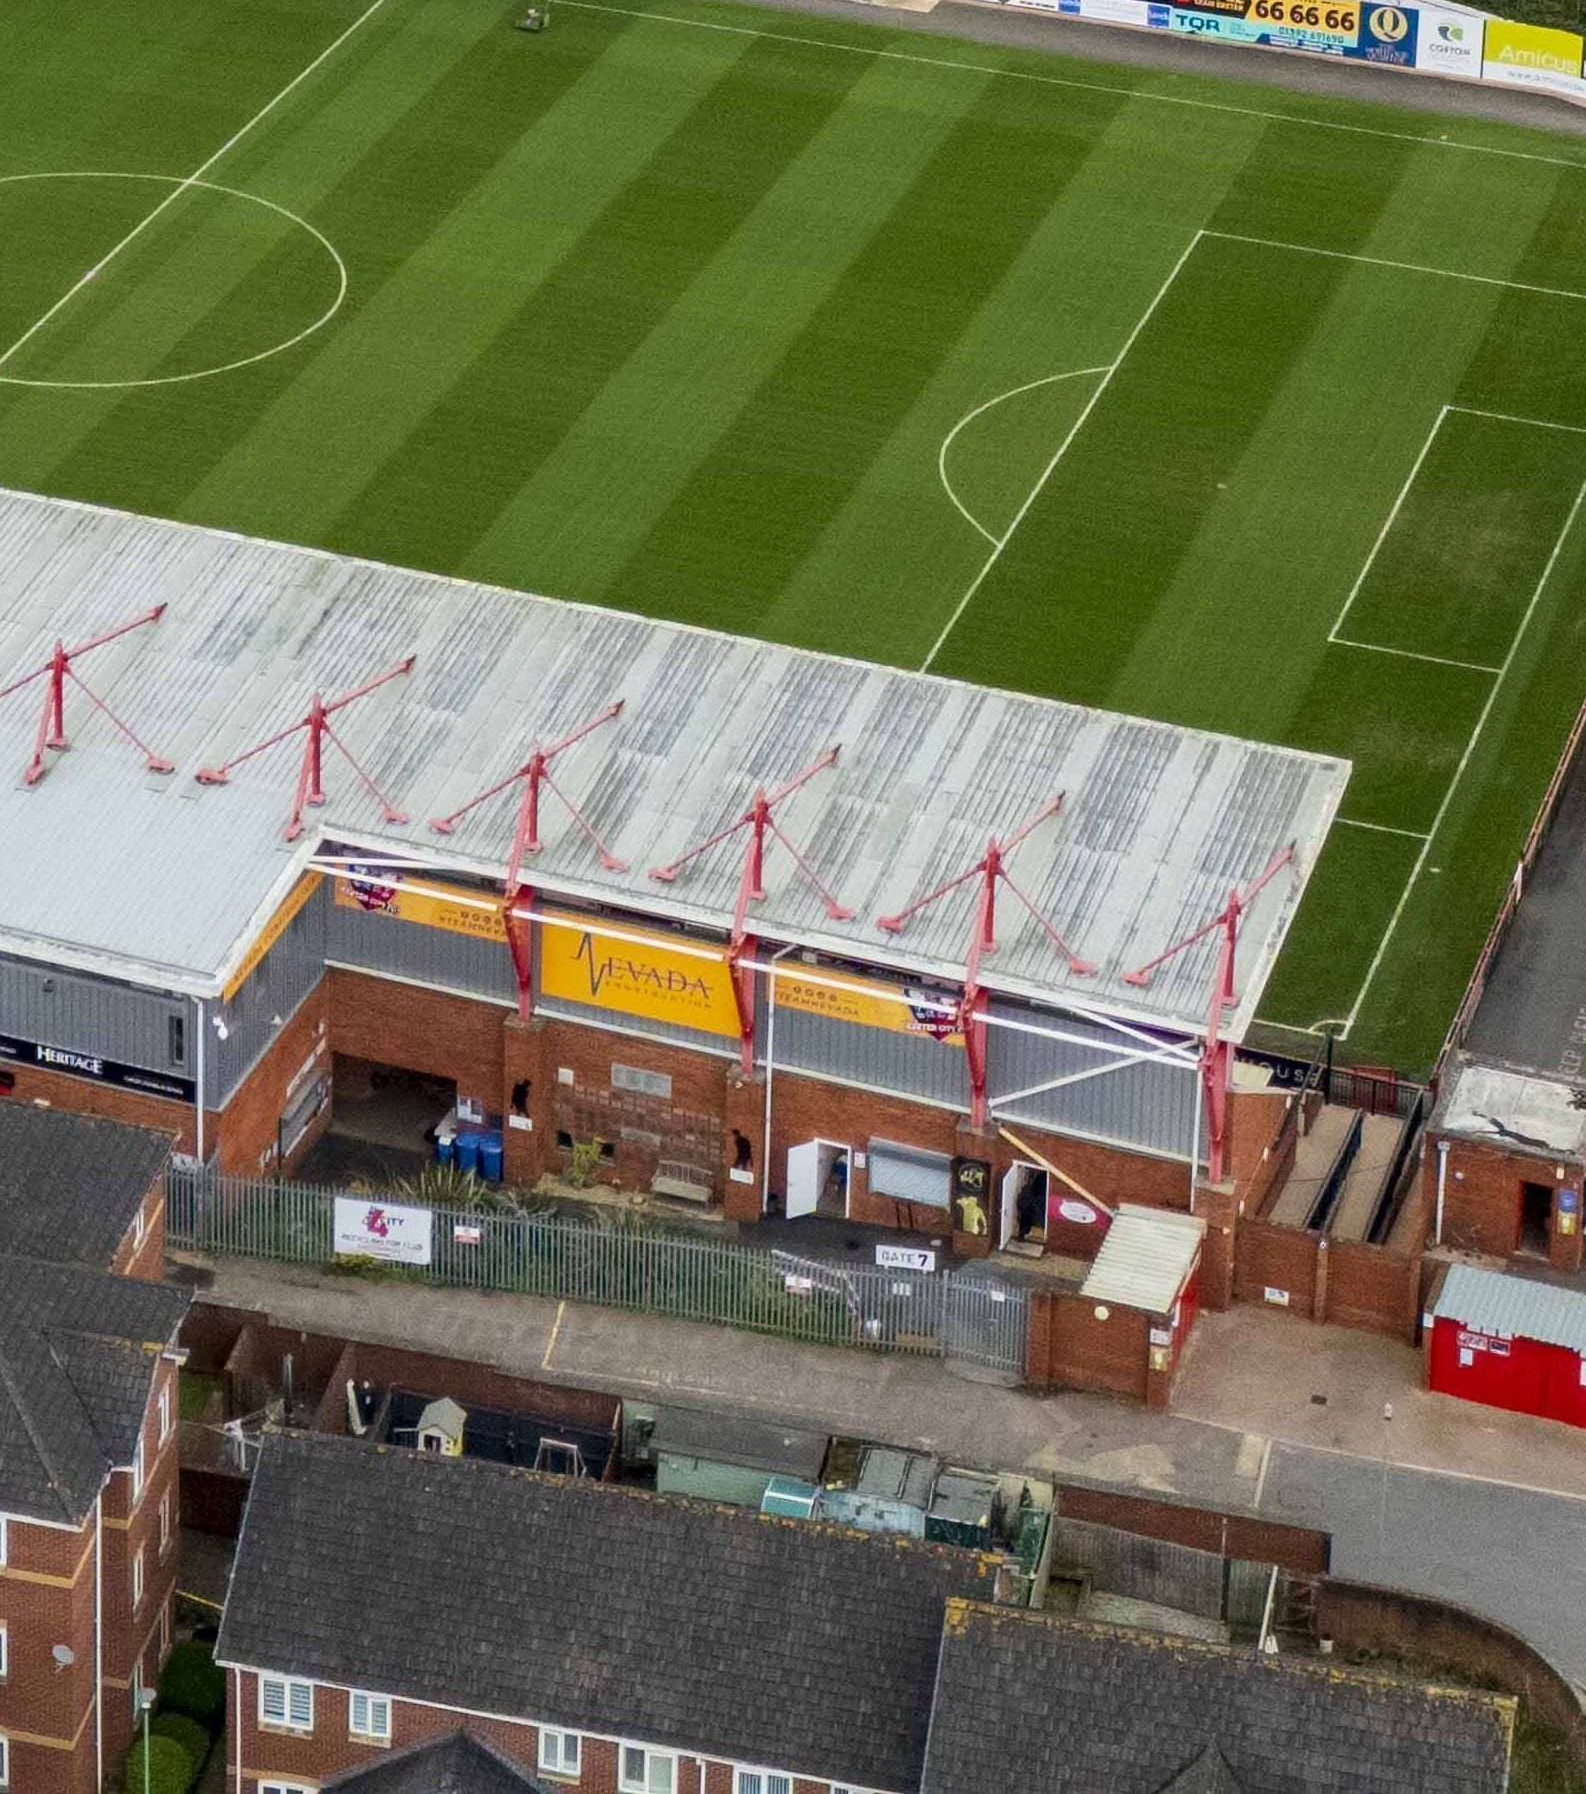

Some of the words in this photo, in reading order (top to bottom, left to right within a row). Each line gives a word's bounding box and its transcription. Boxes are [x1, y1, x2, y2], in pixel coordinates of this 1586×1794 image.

[1176, 14, 1220, 32] TQR
[1255, 0, 1284, 21] 66
[1290, 4, 1319, 26] 66
[1325, 9, 1355, 32] 66
[1498, 44, 1578, 74] Amicus
[570, 932, 714, 999] NEVADA
[777, 992, 859, 1020] TEAMNEVADA
[36, 1045, 103, 1075] HERITAGE
[881, 1249, 913, 1265] GATE
[917, 1253, 928, 1267] 7
